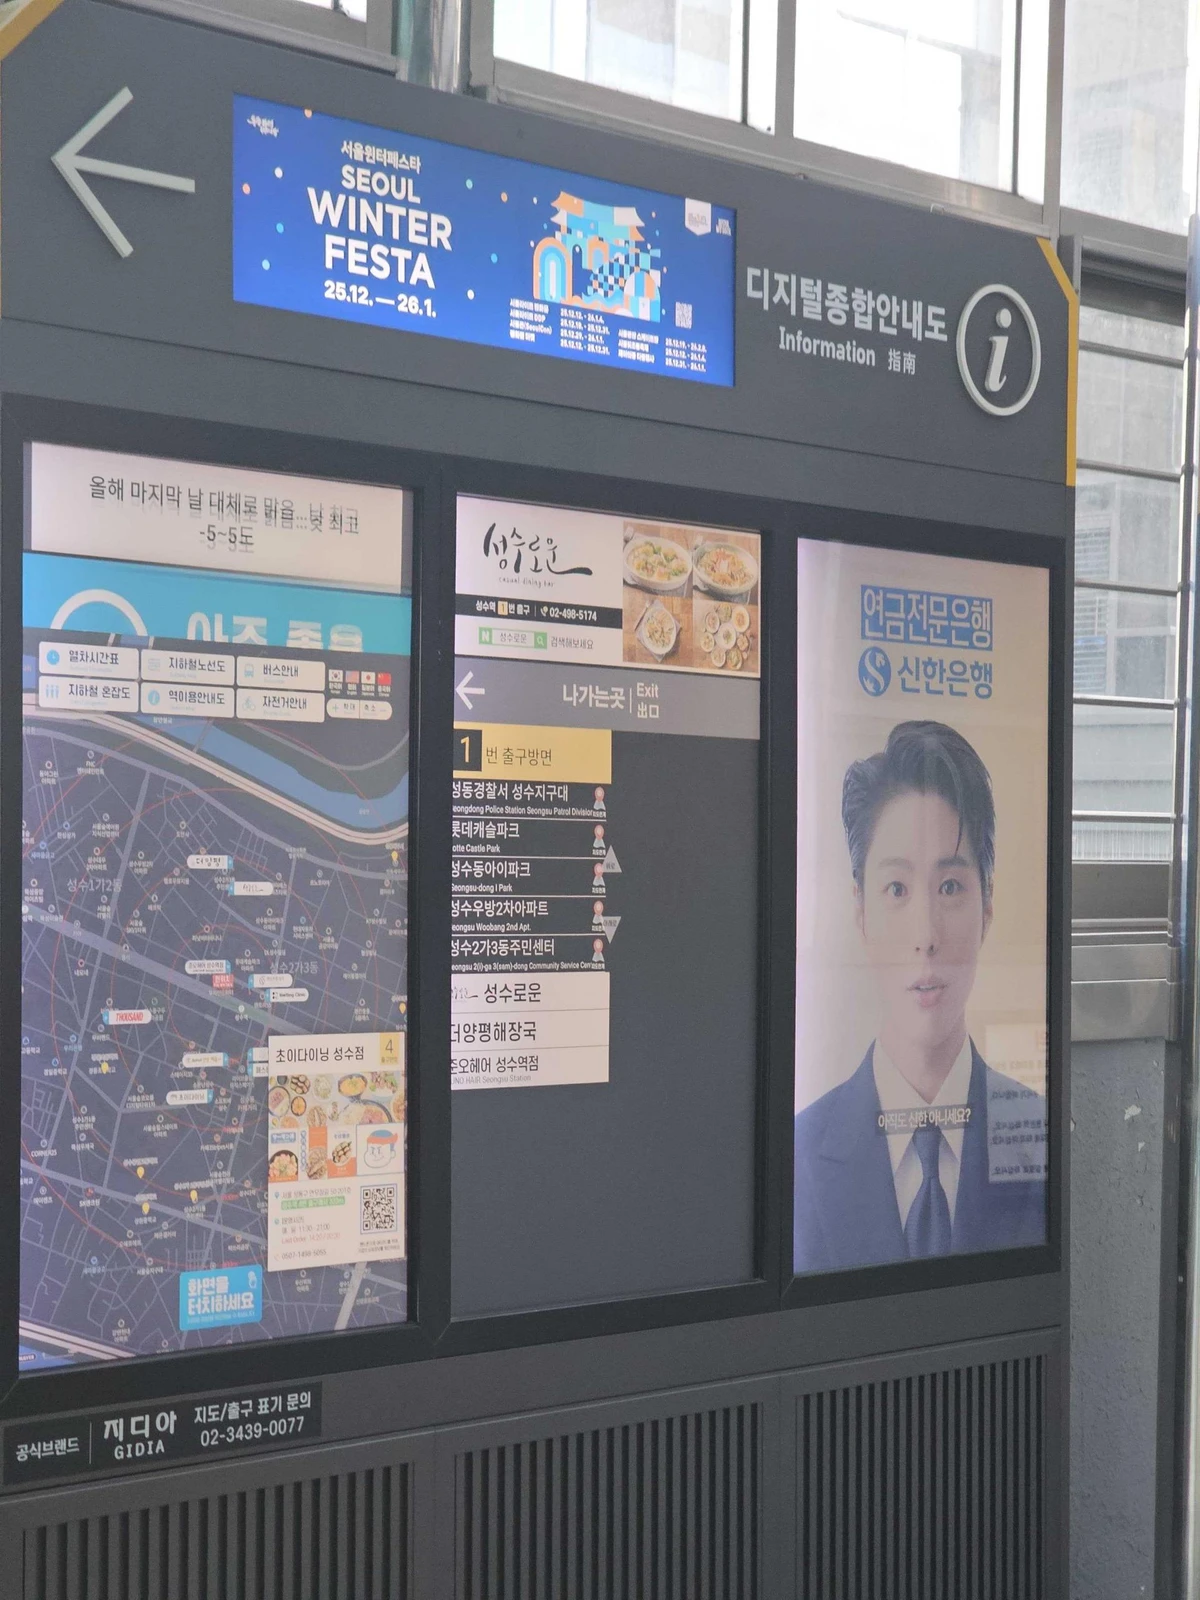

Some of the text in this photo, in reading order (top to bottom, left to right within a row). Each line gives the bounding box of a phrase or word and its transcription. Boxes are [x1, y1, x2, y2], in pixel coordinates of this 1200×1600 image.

[341, 140, 422, 174] 서울윈터페스타
[341, 165, 421, 204] SEOUL
[307, 187, 452, 251] WINTER
[325, 234, 435, 289] FESTA
[746, 266, 948, 342] 디지털종합안내도
[778, 325, 916, 375] Information 指南
[89, 475, 124, 501] 올해
[130, 480, 182, 508] 마지막
[188, 488, 203, 511] 날
[209, 491, 258, 520] 대체로
[328, 503, 360, 535] 최고
[476, 600, 496, 612] 성수역
[550, 608, 597, 621] 02-498-5174
[863, 588, 991, 648] 연금전문은행
[500, 632, 527, 644] 성수로운
[551, 636, 594, 649] 검색해보세요
[69, 650, 119, 665] 열차시간표
[169, 657, 226, 672] 지하철노선도
[263, 664, 299, 677] 버스안내
[897, 656, 993, 699] 신한은행
[68, 683, 131, 699] 지하철 혼잡도
[169, 690, 226, 705] 역이용안내도
[562, 683, 625, 709] 나가는곳
[636, 682, 659, 699] Exit
[263, 696, 307, 710] 자전거안내
[637, 703, 659, 719] 出口
[460, 736, 552, 767] 1 번 출구방면
[511, 783, 568, 802] 성수지구대
[452, 804, 484, 815] eongdong
[485, 805, 504, 814] Police
[505, 806, 525, 814] Station
[527, 806, 552, 816] Seongsu
[553, 807, 570, 816] Patrol
[452, 844, 500, 852] otte Castle Park
[67, 878, 122, 892] 성수1가2동
[499, 883, 513, 892] Park
[452, 923, 531, 933] eongsu Woobang 2nd Apt.
[270, 961, 319, 975] 성수2가3동
[451, 963, 472, 972] eongsu
[529, 962, 559, 971] Community
[560, 961, 579, 969] Service
[484, 982, 541, 1003] 성수로운
[116, 1012, 144, 1022] THOUSAND
[275, 1039, 393, 1063] 초이다이닝 성수점 4
[496, 1055, 539, 1073] 성수역점
[510, 1074, 531, 1082] Station
[878, 1108, 972, 1130] 아직도 신한 아니세요?
[187, 1275, 230, 1296] 화면을
[187, 1291, 254, 1316] 터치하세요
[194, 1391, 311, 1424] 지도/출구 표기 문의
[201, 1416, 304, 1447] 02-3439-0077
[16, 1436, 80, 1462] 공식브랜드
[114, 1439, 165, 1460] GIDIA
